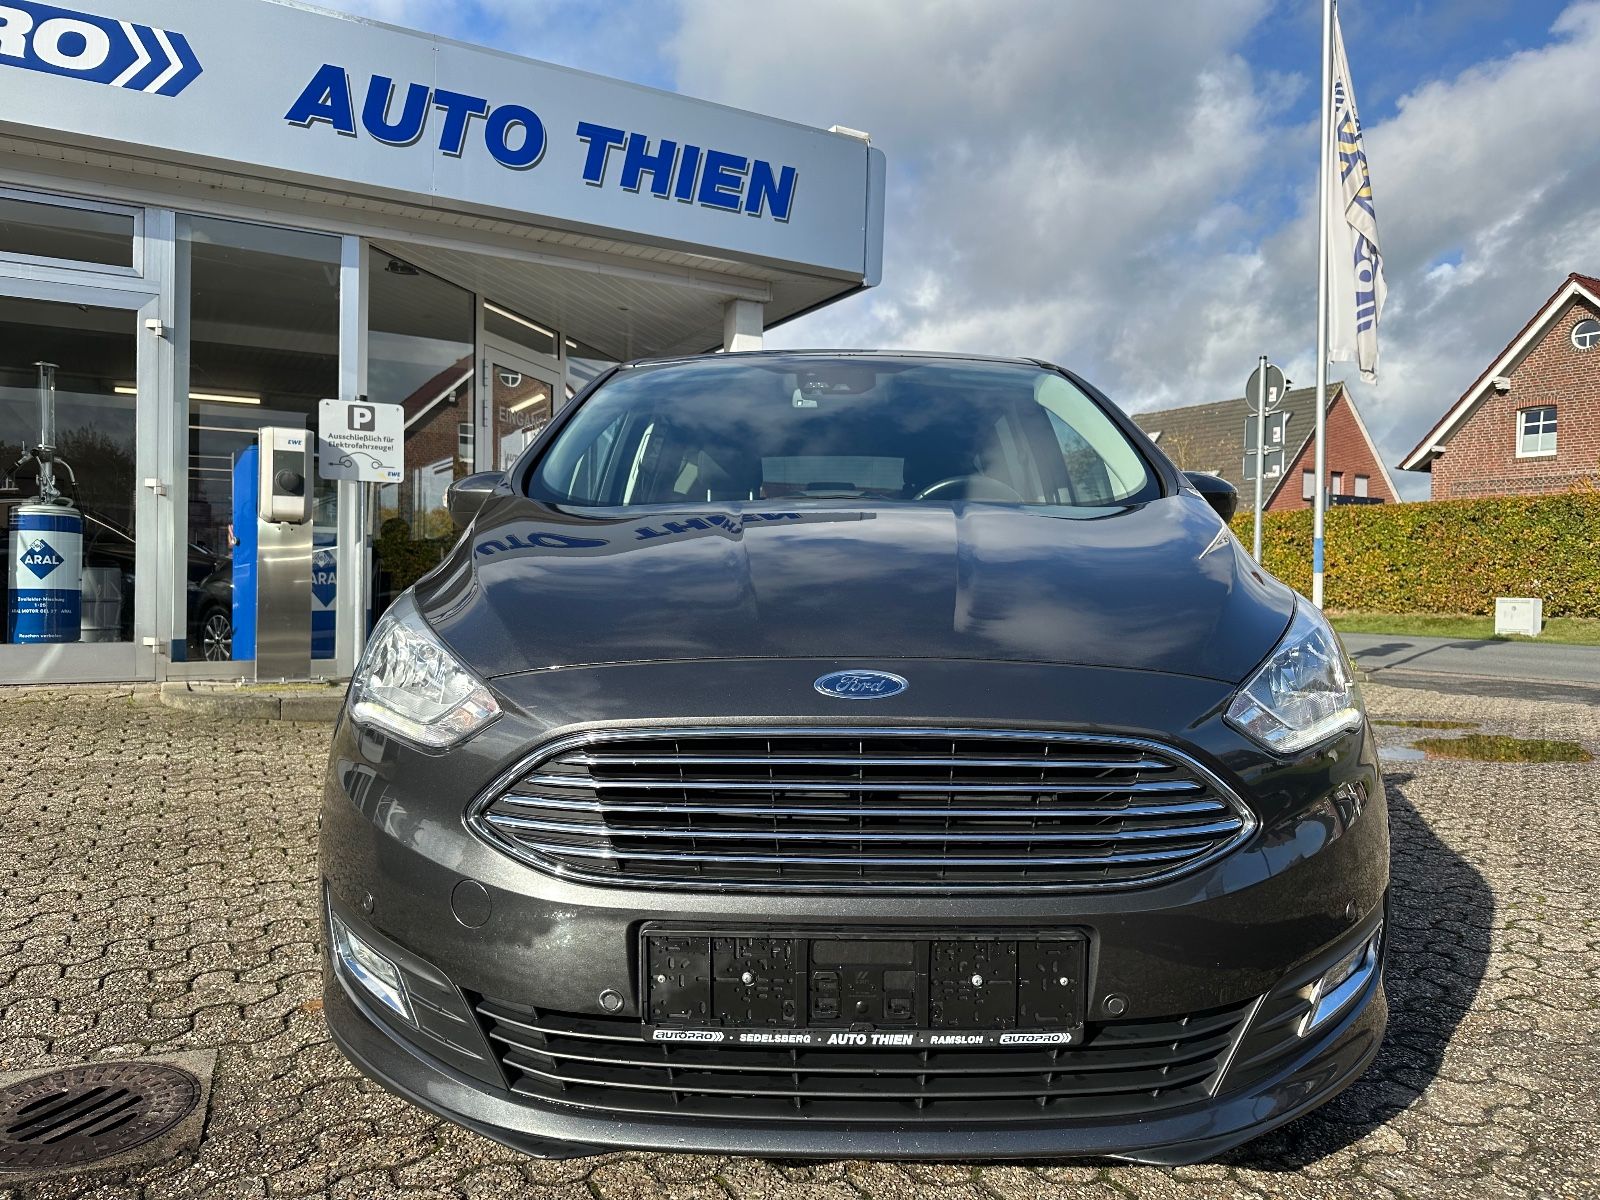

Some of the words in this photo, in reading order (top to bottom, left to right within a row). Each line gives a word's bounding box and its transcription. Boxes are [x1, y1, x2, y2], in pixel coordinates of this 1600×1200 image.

[283, 63, 547, 171] AUTO
[576, 120, 799, 223] THIEN
[353, 406, 372, 429] P
[328, 432, 382, 443] Ausschließlich
[24, 554, 60, 565] ARAL
[835, 675, 886, 692] Ford
[739, 1033, 811, 1043] SEDELSBERG
[827, 1033, 868, 1045] AUTO
[871, 1034, 914, 1045] THIEN
[930, 1035, 984, 1044] RAMSLOH
